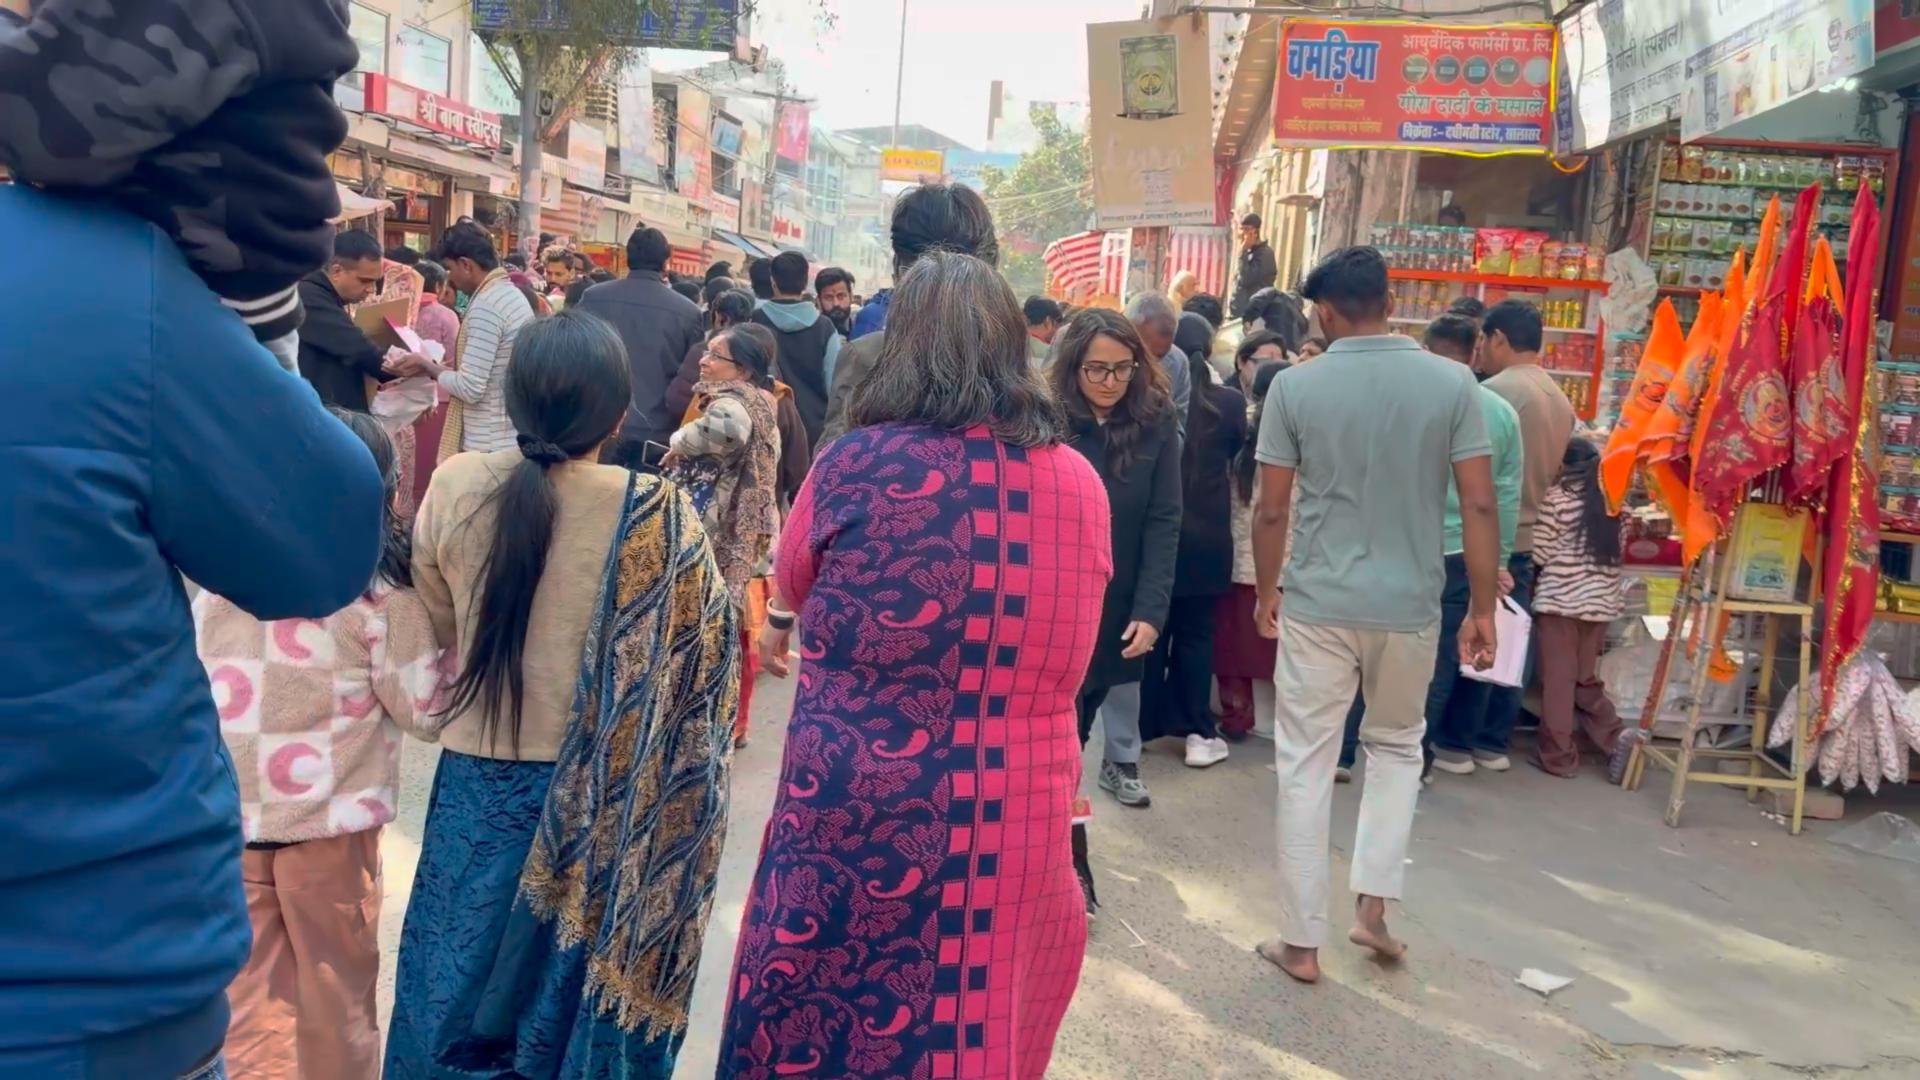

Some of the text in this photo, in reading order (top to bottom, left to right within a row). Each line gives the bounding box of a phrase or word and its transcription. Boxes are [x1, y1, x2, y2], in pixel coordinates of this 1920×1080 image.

[1402, 29, 1465, 56] आयुर्वेदिक
[1468, 31, 1510, 51] फार्मेसी
[1287, 27, 1381, 94] चमड़िया
[420, 93, 437, 125] श्री
[1471, 89, 1493, 114] के
[1495, 89, 1547, 118] मसाले
